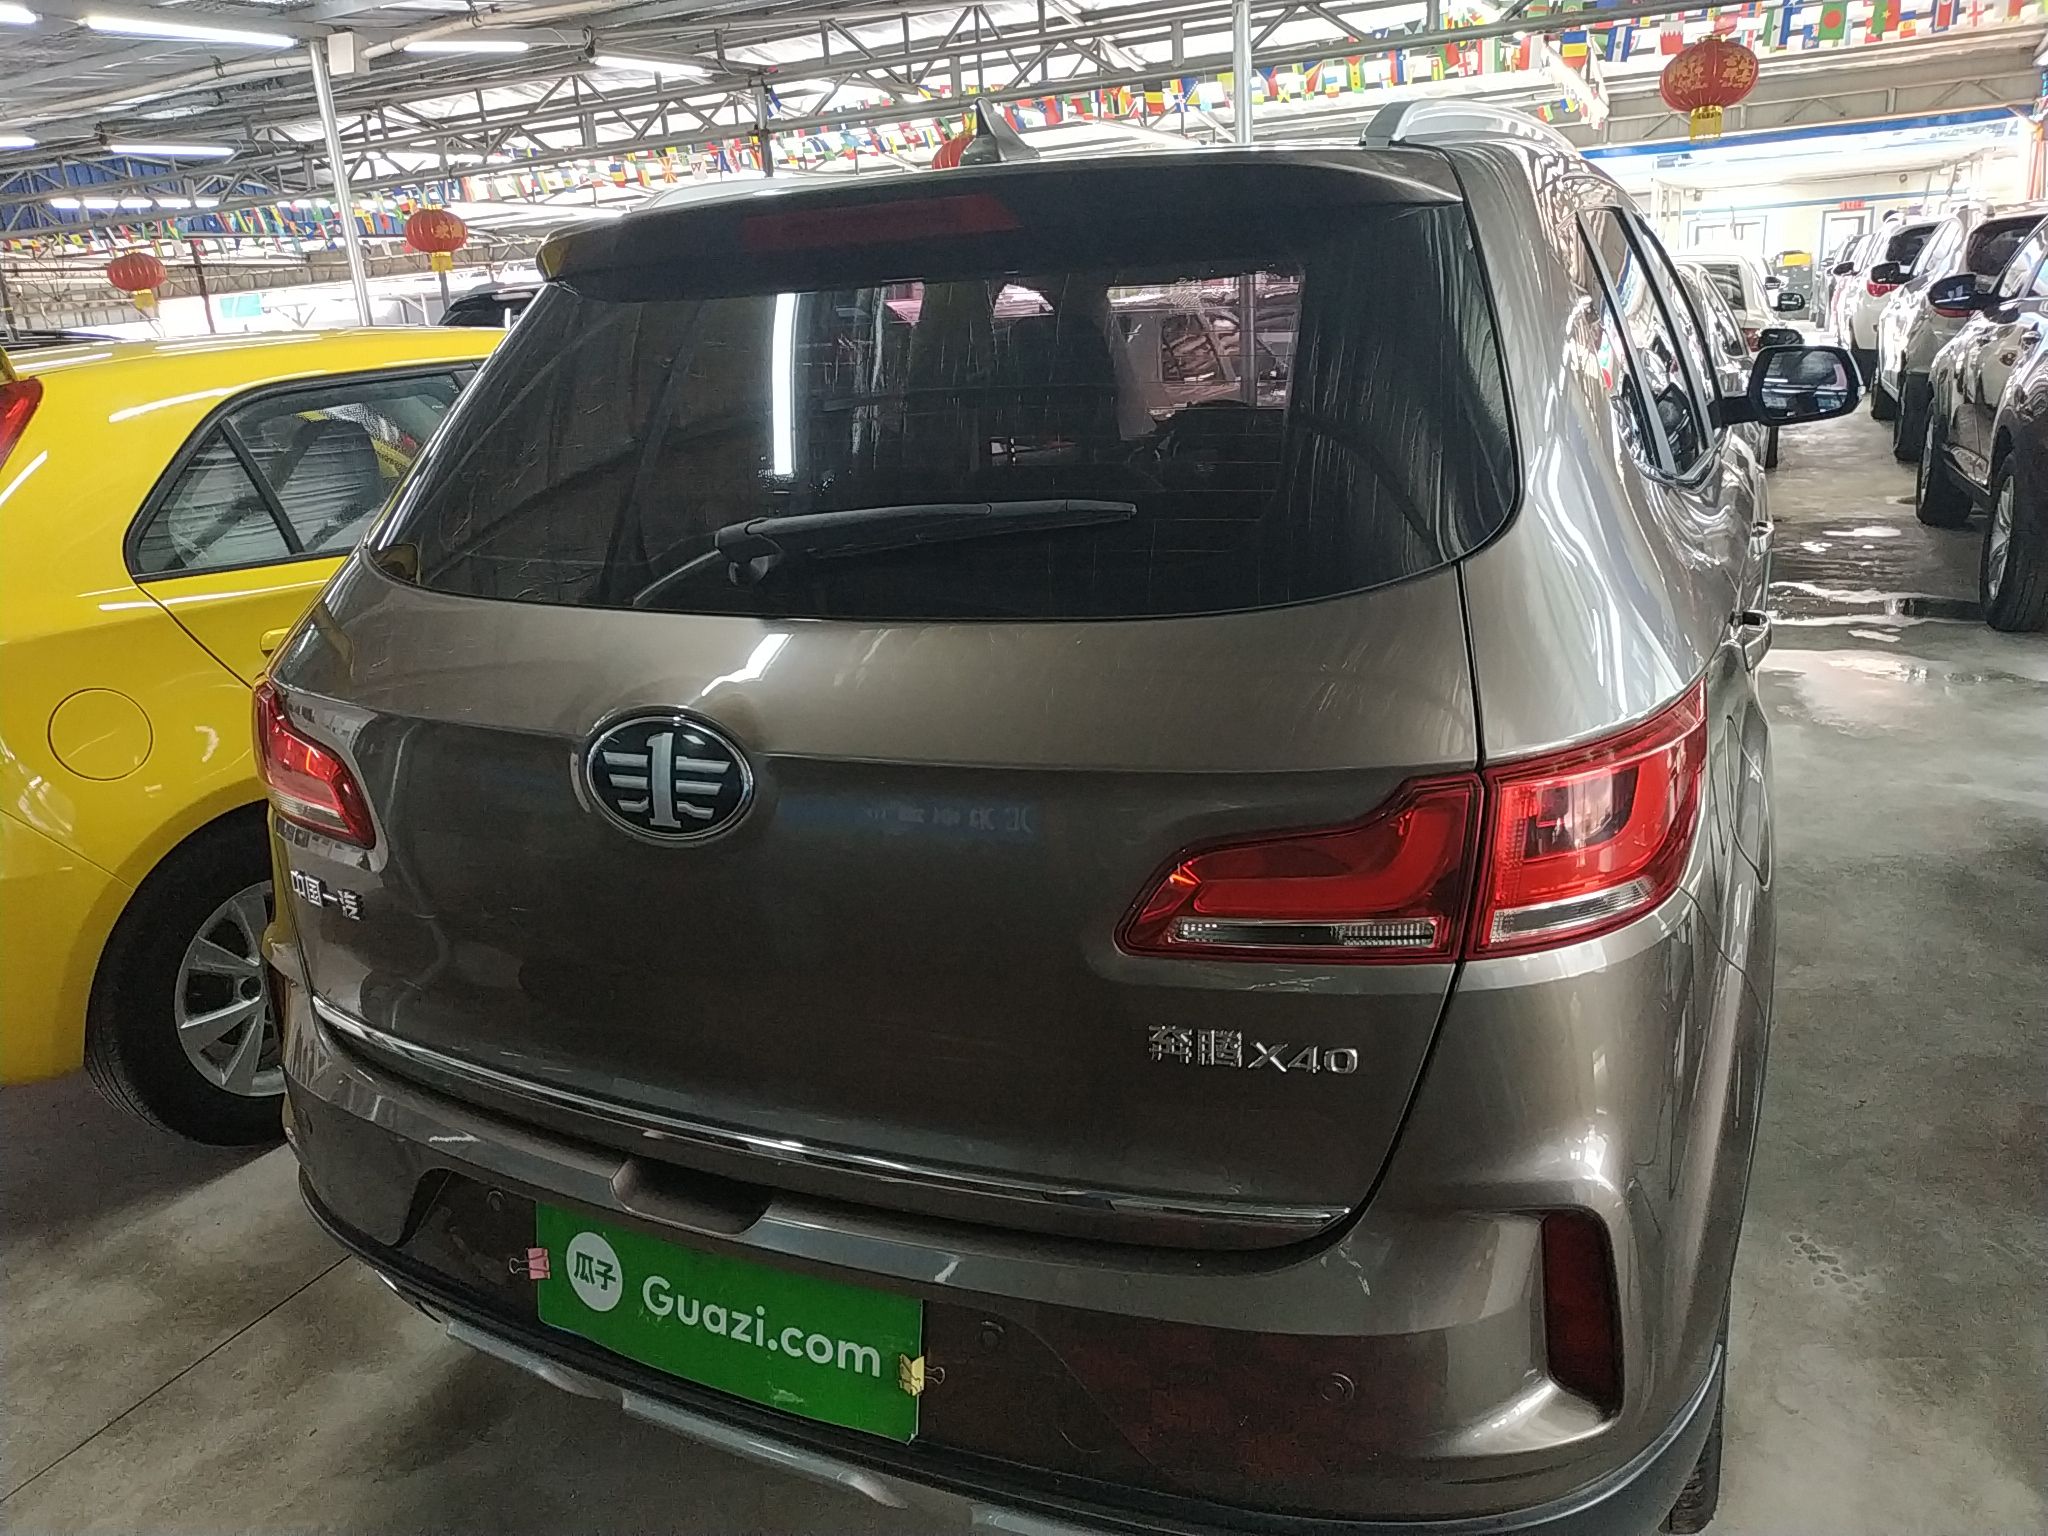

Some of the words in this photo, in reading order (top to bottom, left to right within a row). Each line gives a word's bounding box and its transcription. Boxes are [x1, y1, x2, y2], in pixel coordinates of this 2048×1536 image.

[290, 869, 361, 921] 中国一汽
[573, 1251, 617, 1291] 瓜子
[642, 1275, 881, 1378] Guazi.com
